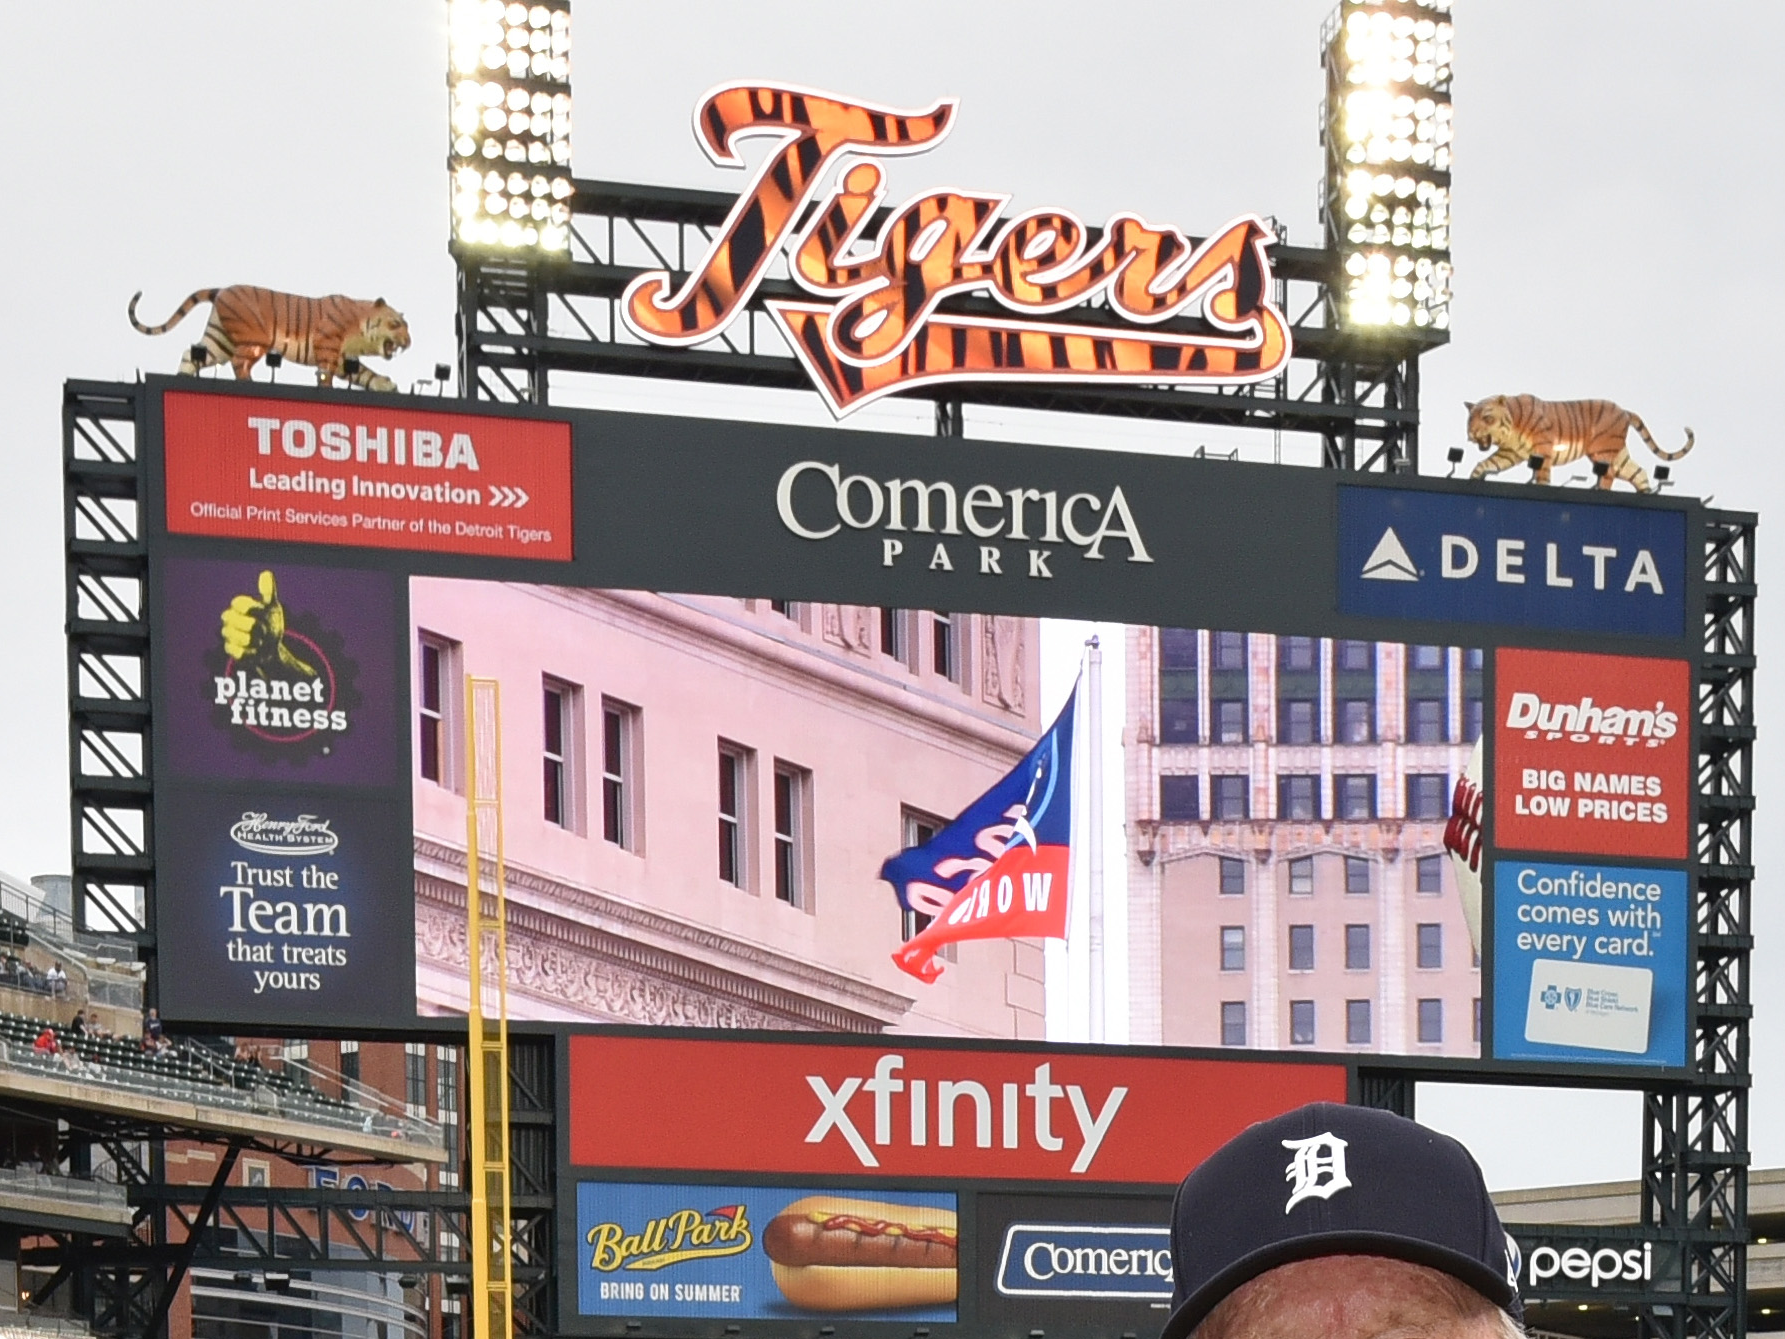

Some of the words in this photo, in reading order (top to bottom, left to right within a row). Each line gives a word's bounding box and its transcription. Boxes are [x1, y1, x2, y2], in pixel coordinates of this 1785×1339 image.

[621, 80, 1289, 395] Tigers
[247, 416, 480, 471] TOSHIBA
[249, 467, 346, 500] Leading
[352, 475, 481, 505] Innovation
[190, 501, 242, 520] Official
[247, 504, 281, 522] Print
[285, 508, 348, 528] Services
[352, 512, 406, 531] Partner
[409, 517, 424, 533] of
[428, 519, 451, 535] the
[455, 521, 503, 539] Detroit
[507, 525, 552, 543] Tigers
[882, 538, 1053, 579] PARK
[1440, 534, 1664, 595] DELTA
[215, 670, 325, 705] planet
[230, 699, 347, 731] fitness
[1506, 692, 1679, 739] Dunham's
[1524, 730, 1661, 748] SPORTS
[1522, 768, 1566, 790] BIG
[1574, 772, 1662, 797] NAMES
[242, 811, 296, 836] Henry
[293, 814, 330, 834] Ford
[1515, 794, 1571, 817] LOW
[1577, 798, 1668, 824] PRICES
[231, 861, 294, 888] Trust
[301, 864, 339, 890] the
[1518, 868, 1661, 901] Confidence
[219, 886, 351, 937] Team
[1517, 904, 1600, 926] comes
[1608, 904, 1661, 930] with
[226, 937, 274, 964] that
[282, 940, 347, 966] treats
[1517, 931, 1587, 959] every
[1594, 931, 1654, 957] card.
[253, 970, 321, 994] yours
[804, 1054, 1128, 1173] xfinity
[1281, 1131, 1352, 1215] D
[587, 1218, 668, 1272] Ball
[668, 1205, 751, 1250] Park
[1024, 1242, 1175, 1282] Comeric
[1529, 1241, 1652, 1287] pepsi
[600, 1282, 645, 1300] BRING
[649, 1283, 669, 1301] ON
[675, 1284, 741, 1303] SUMMER
